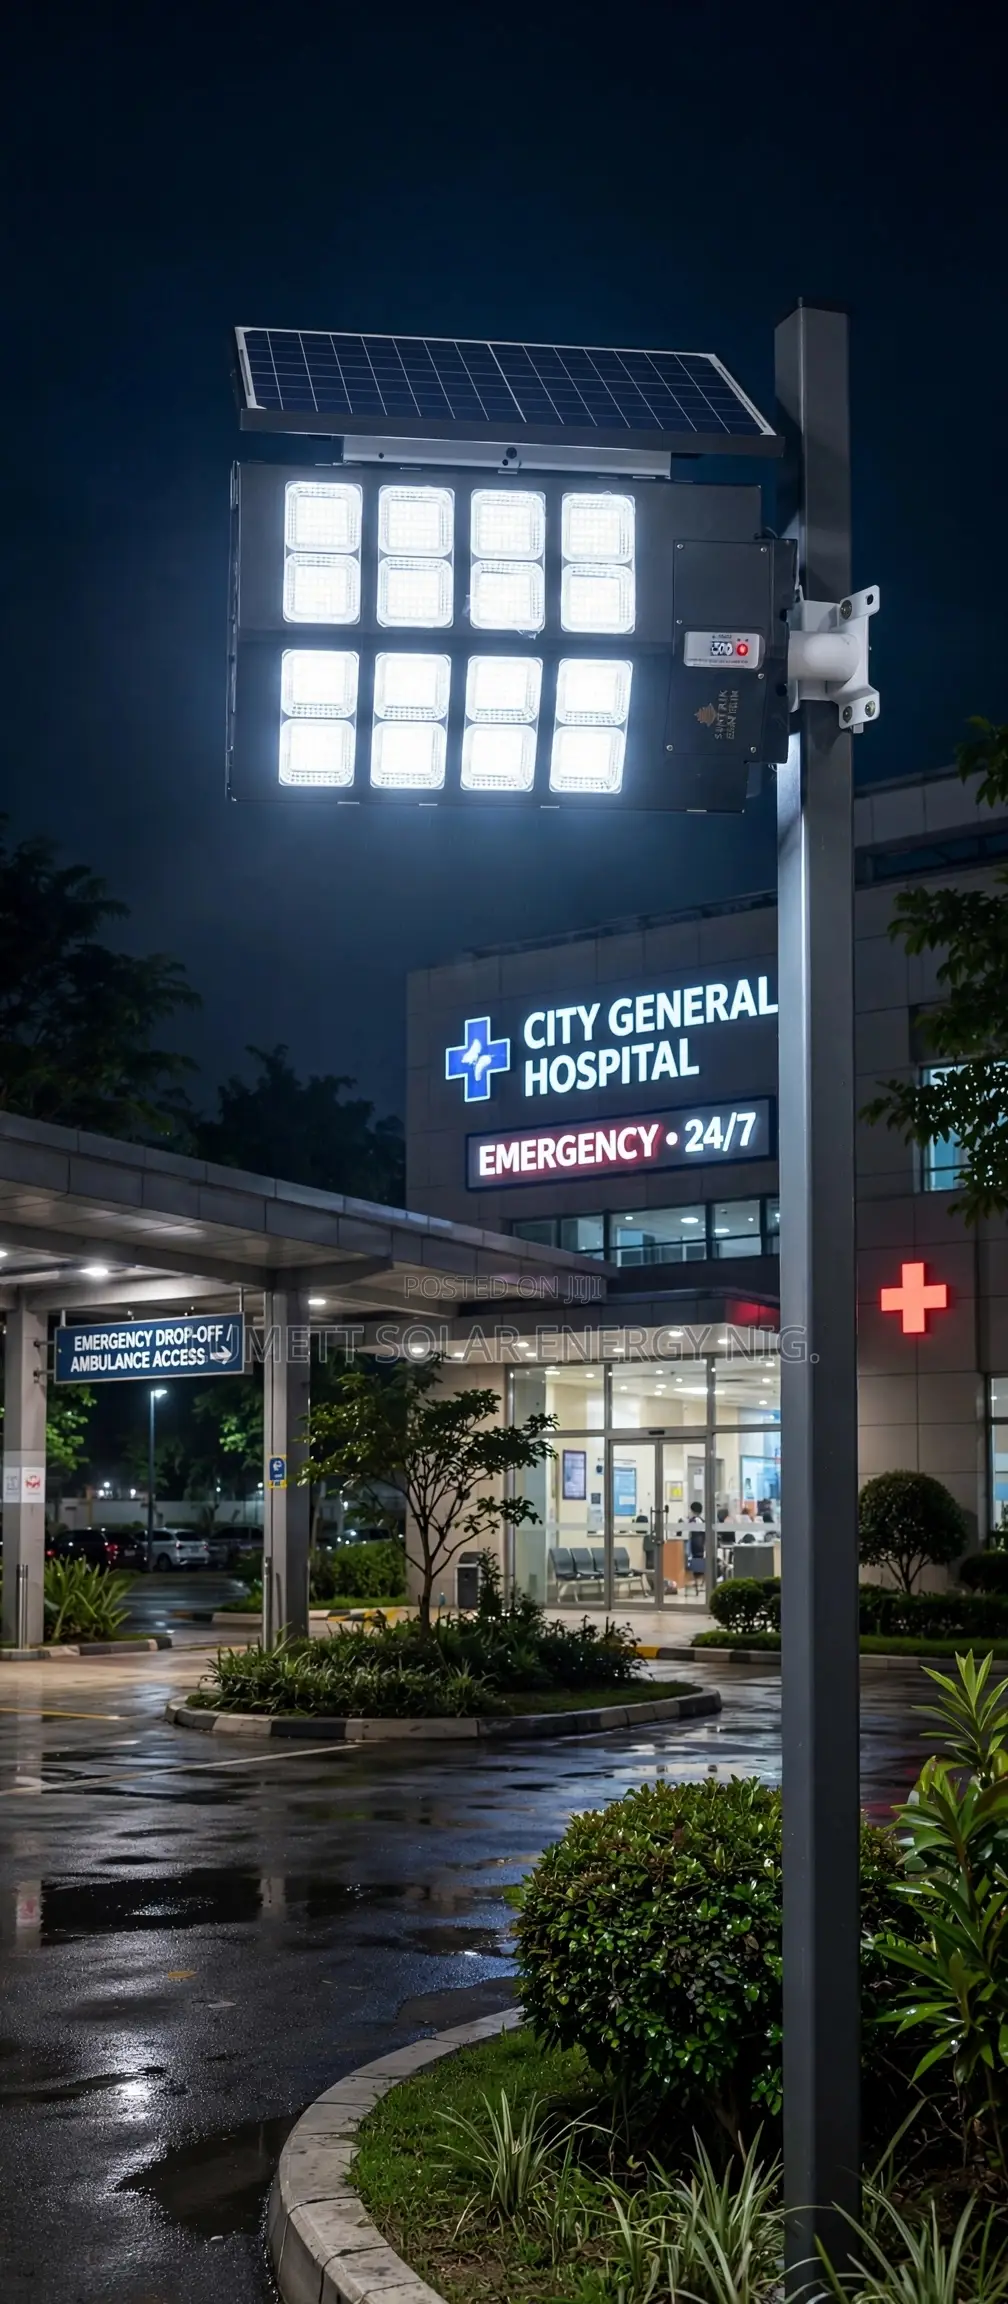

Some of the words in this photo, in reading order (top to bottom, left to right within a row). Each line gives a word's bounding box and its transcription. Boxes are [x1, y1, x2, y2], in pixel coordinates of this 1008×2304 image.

[523, 1002, 601, 1049] CITY
[608, 976, 779, 1036] GENERAL
[524, 1038, 700, 1097] HOSPITAL
[479, 1123, 660, 1176] EMERGENCY
[684, 1111, 757, 1153] 24/7
[70, 1351, 150, 1373] AMBULANCE
[152, 1347, 206, 1367] ACCESS
[74, 1330, 153, 1352] EMERGENCY
[155, 1325, 224, 1346] DROP-OFF
